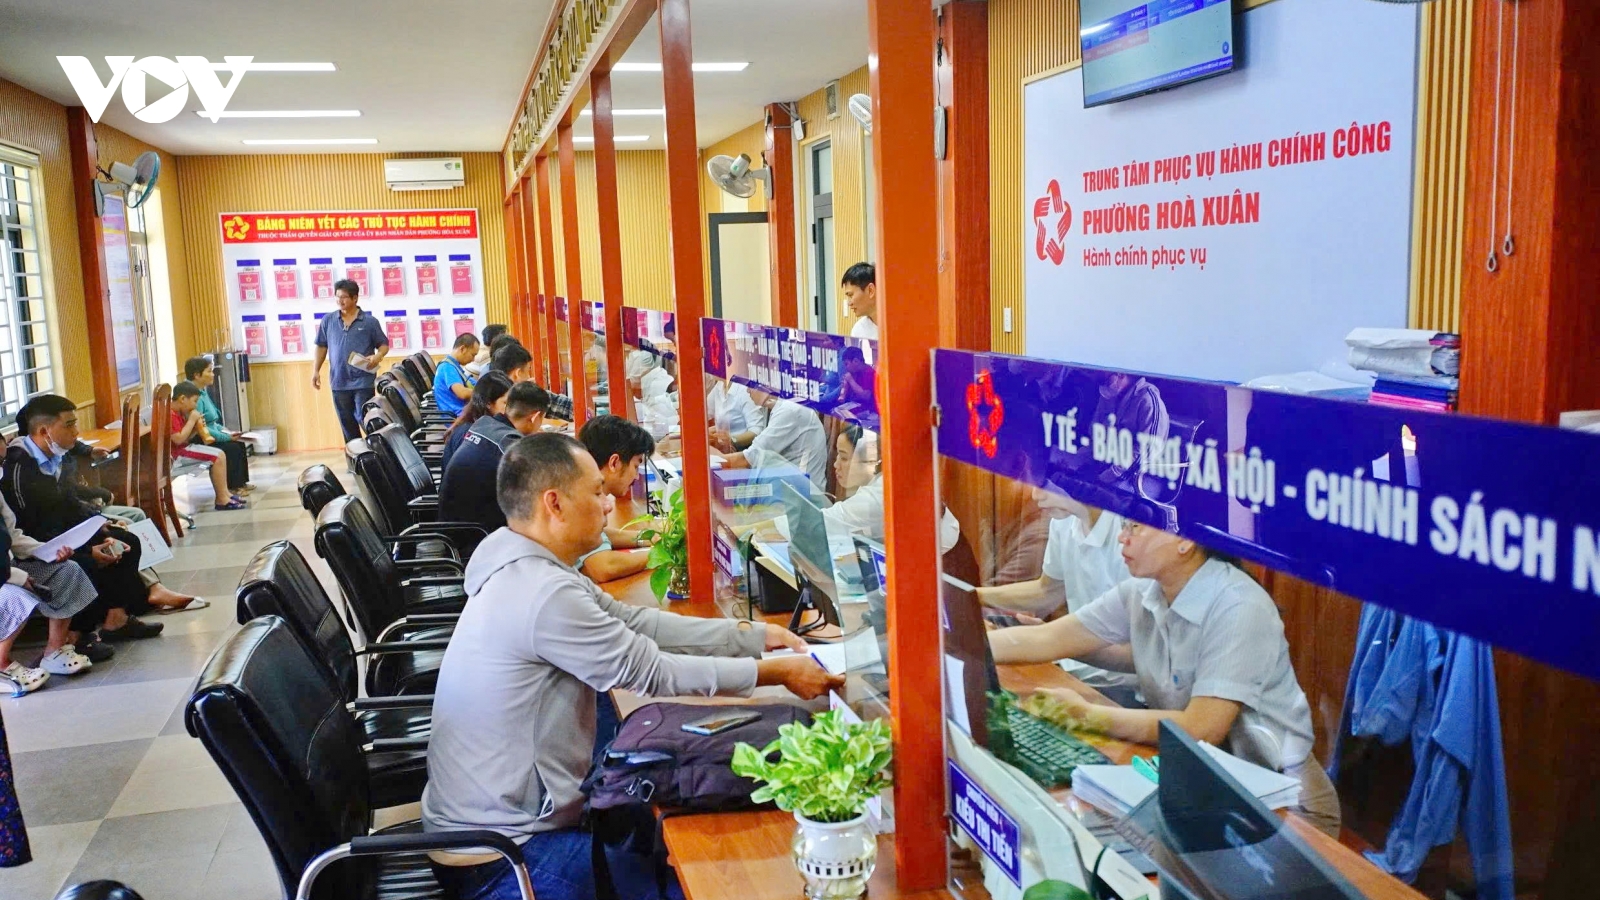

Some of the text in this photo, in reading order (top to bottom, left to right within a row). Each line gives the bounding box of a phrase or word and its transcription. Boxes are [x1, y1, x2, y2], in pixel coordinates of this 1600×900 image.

[1083, 120, 1391, 193] TRUNG TÂM PHỤC VỤ HÀNH CHÍNH CÔNG
[257, 216, 285, 231] BẢNG
[318, 214, 336, 229] YẾT
[339, 216, 360, 229] CÁC
[362, 214, 383, 229] THỦ
[385, 216, 406, 230] TỤC
[409, 215, 437, 228] HÀNH
[439, 214, 471, 227] CHÍNH
[1083, 189, 1260, 235] PHƯỜNG HOÀ XUÂN
[1083, 245, 1207, 271] Hành chính phục vụ
[811, 346, 821, 368] DU
[822, 347, 838, 375] LỊCH
[1041, 411, 1053, 448] Y
[1055, 407, 1078, 454] TẾ
[1080, 436, 1089, 446] -
[1092, 414, 1133, 469] BẢO
[1136, 431, 1182, 490] TRỢ
[1186, 438, 1221, 493] XÃ
[1226, 446, 1276, 514] HỘI
[1283, 484, 1297, 499] -
[1305, 467, 1419, 546] CHÍNH
[1429, 490, 1557, 582] SÁCH
[975, 812, 991, 851] THỊ
